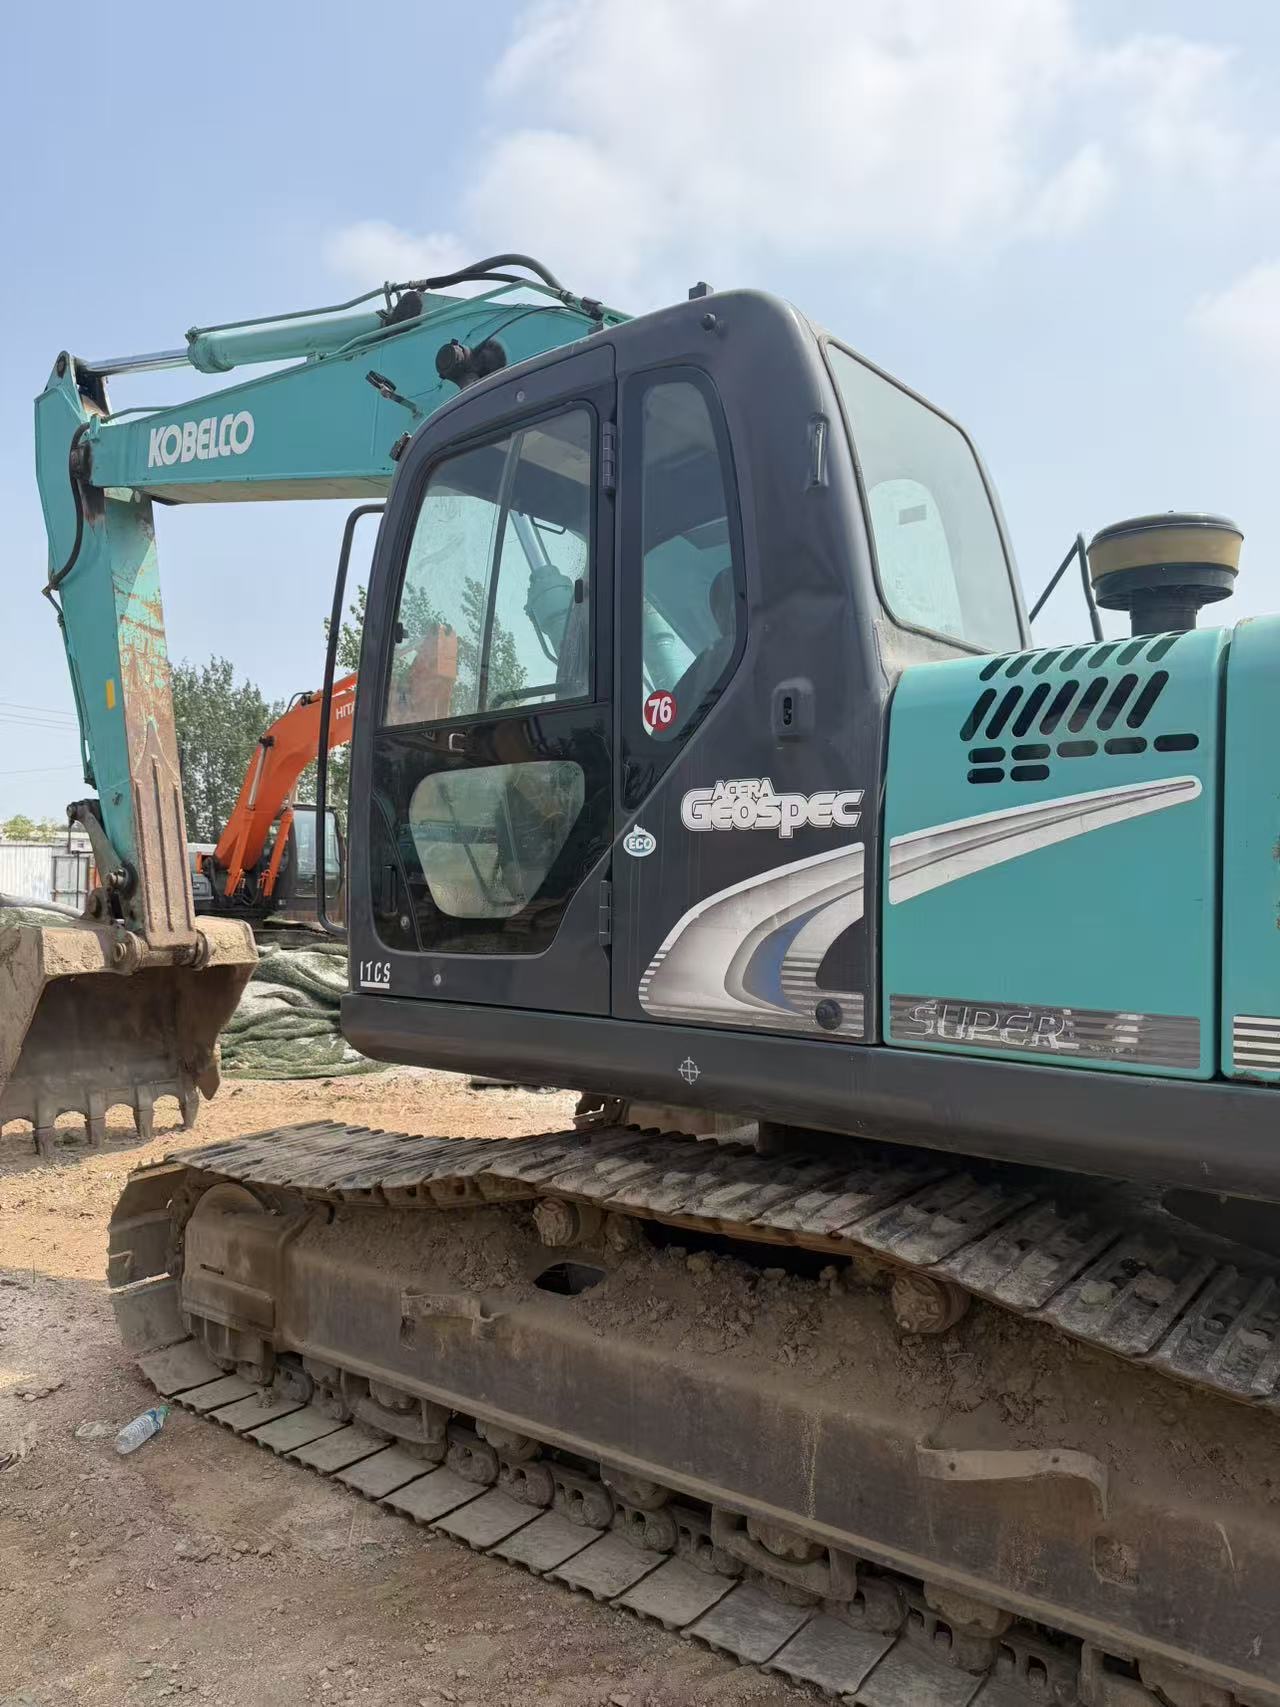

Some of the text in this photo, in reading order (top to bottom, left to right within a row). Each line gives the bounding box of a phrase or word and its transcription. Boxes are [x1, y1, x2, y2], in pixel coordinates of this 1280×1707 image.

[148, 410, 255, 468] KOBELCO
[648, 696, 672, 725] 76
[713, 777, 774, 801] ACERA
[628, 837, 653, 850] ECO
[360, 961, 390, 982] ITCS
[904, 999, 1072, 1050] SUPER
